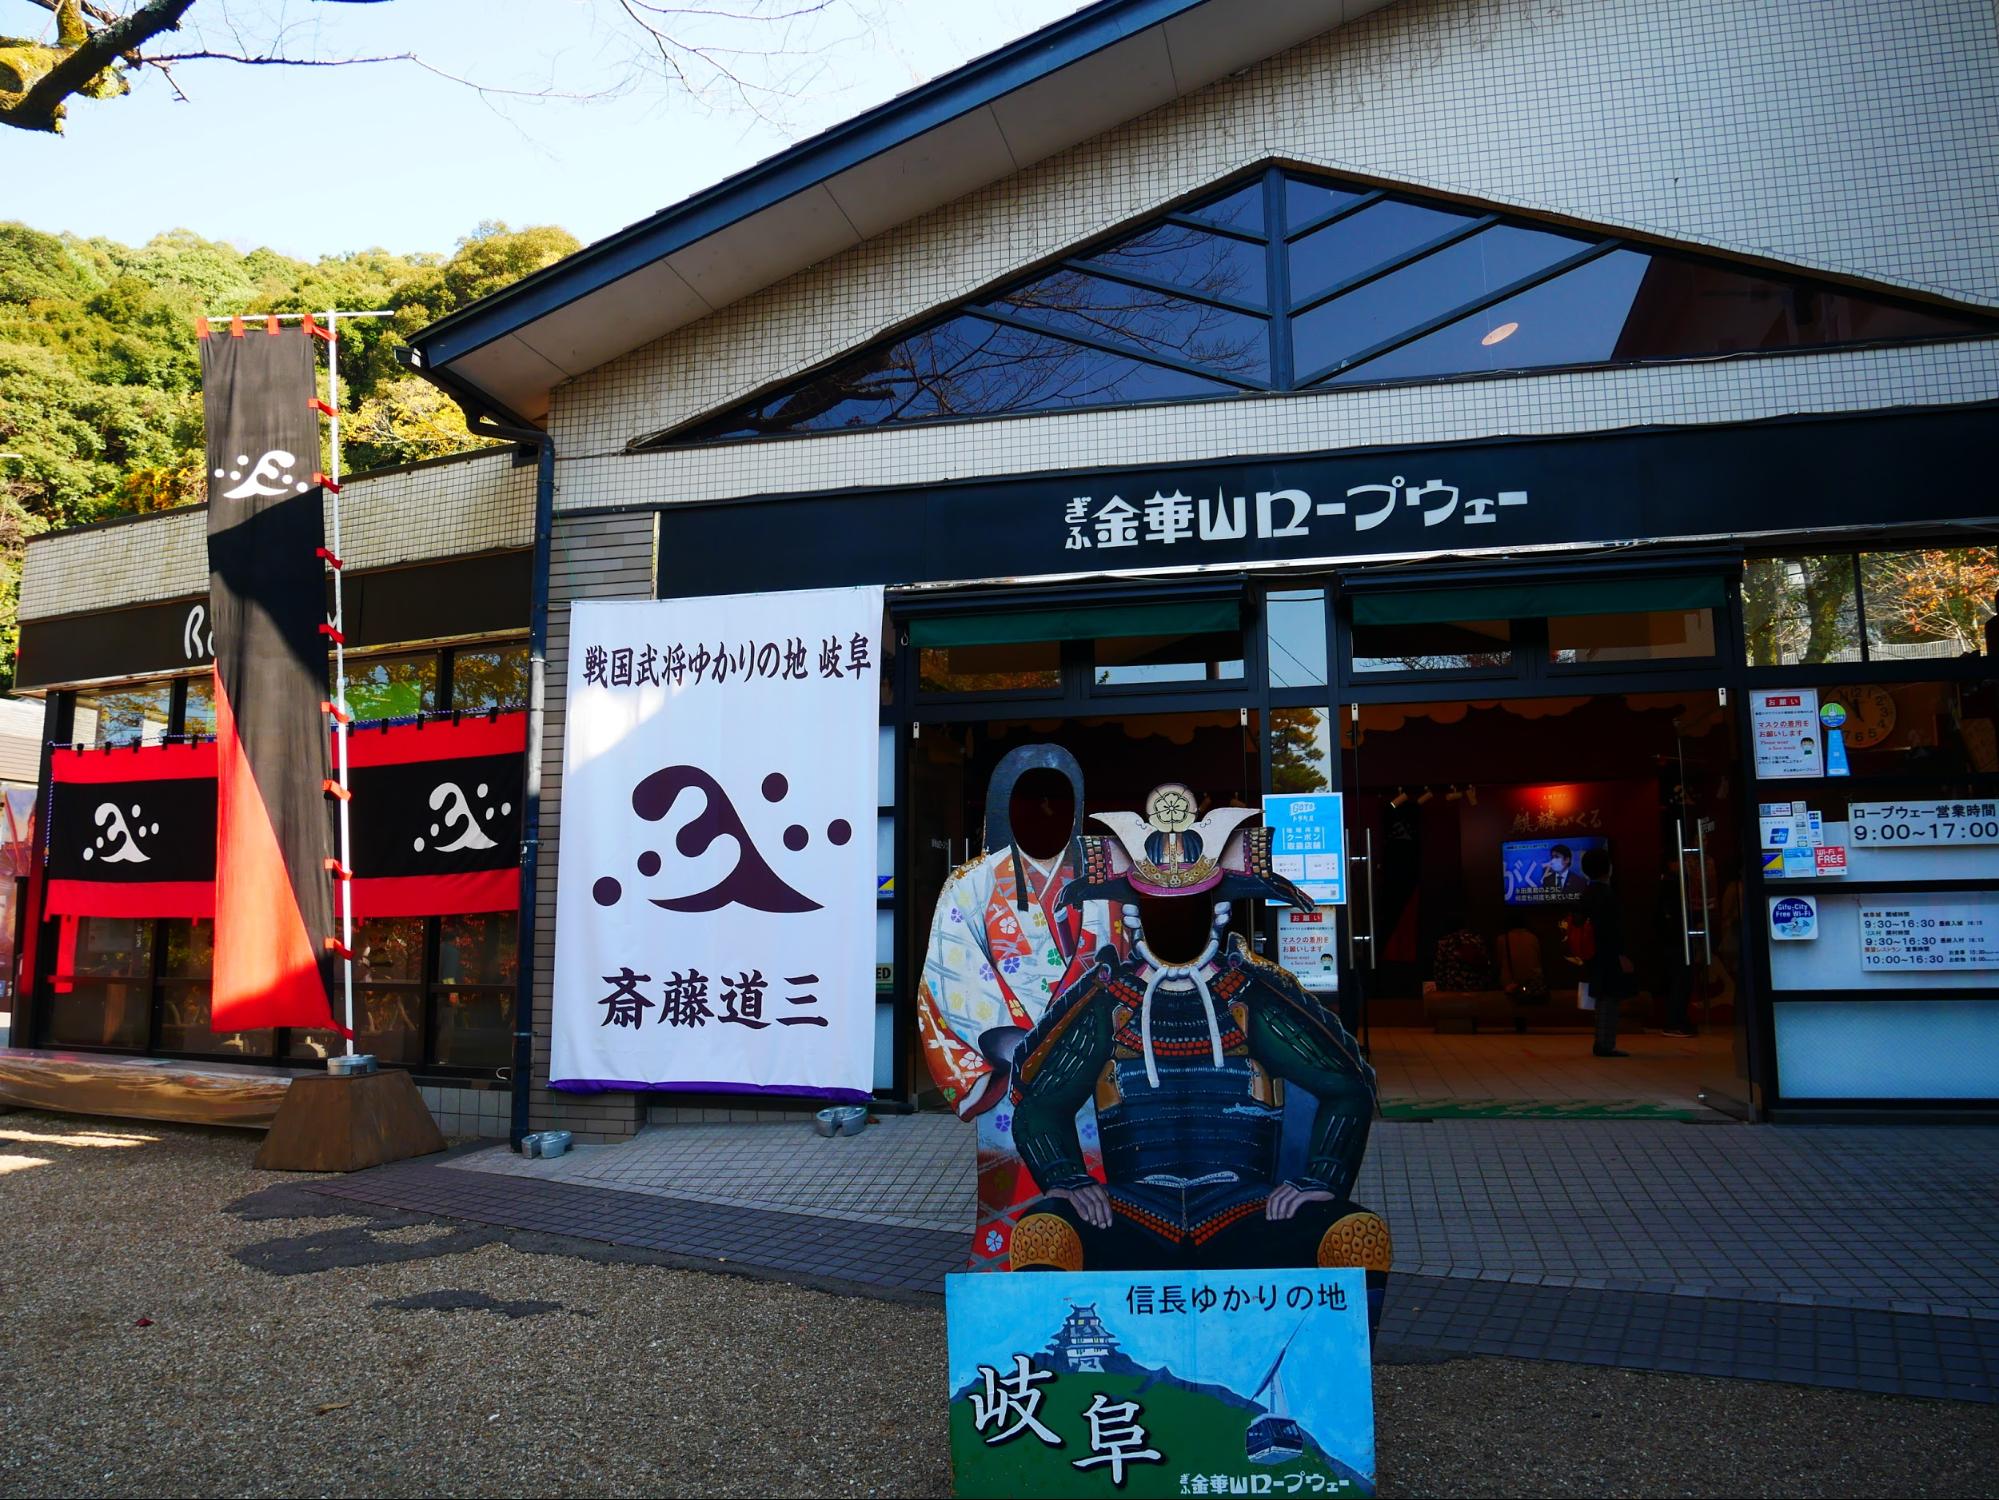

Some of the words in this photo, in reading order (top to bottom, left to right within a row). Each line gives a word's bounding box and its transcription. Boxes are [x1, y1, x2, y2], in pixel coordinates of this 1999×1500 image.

[582, 636, 808, 689] 戦国武将ゆかりの地
[818, 632, 872, 680] 岐阜
[1758, 719, 1809, 729] マスクの着用を
[1759, 730, 1803, 738] お願いします
[1853, 803, 1996, 820] ロープウェー営業時間
[1817, 854, 1844, 864] FREE
[598, 967, 829, 1031] 斎藤道三
[1126, 1282, 1348, 1315] 信長ゆかりの地
